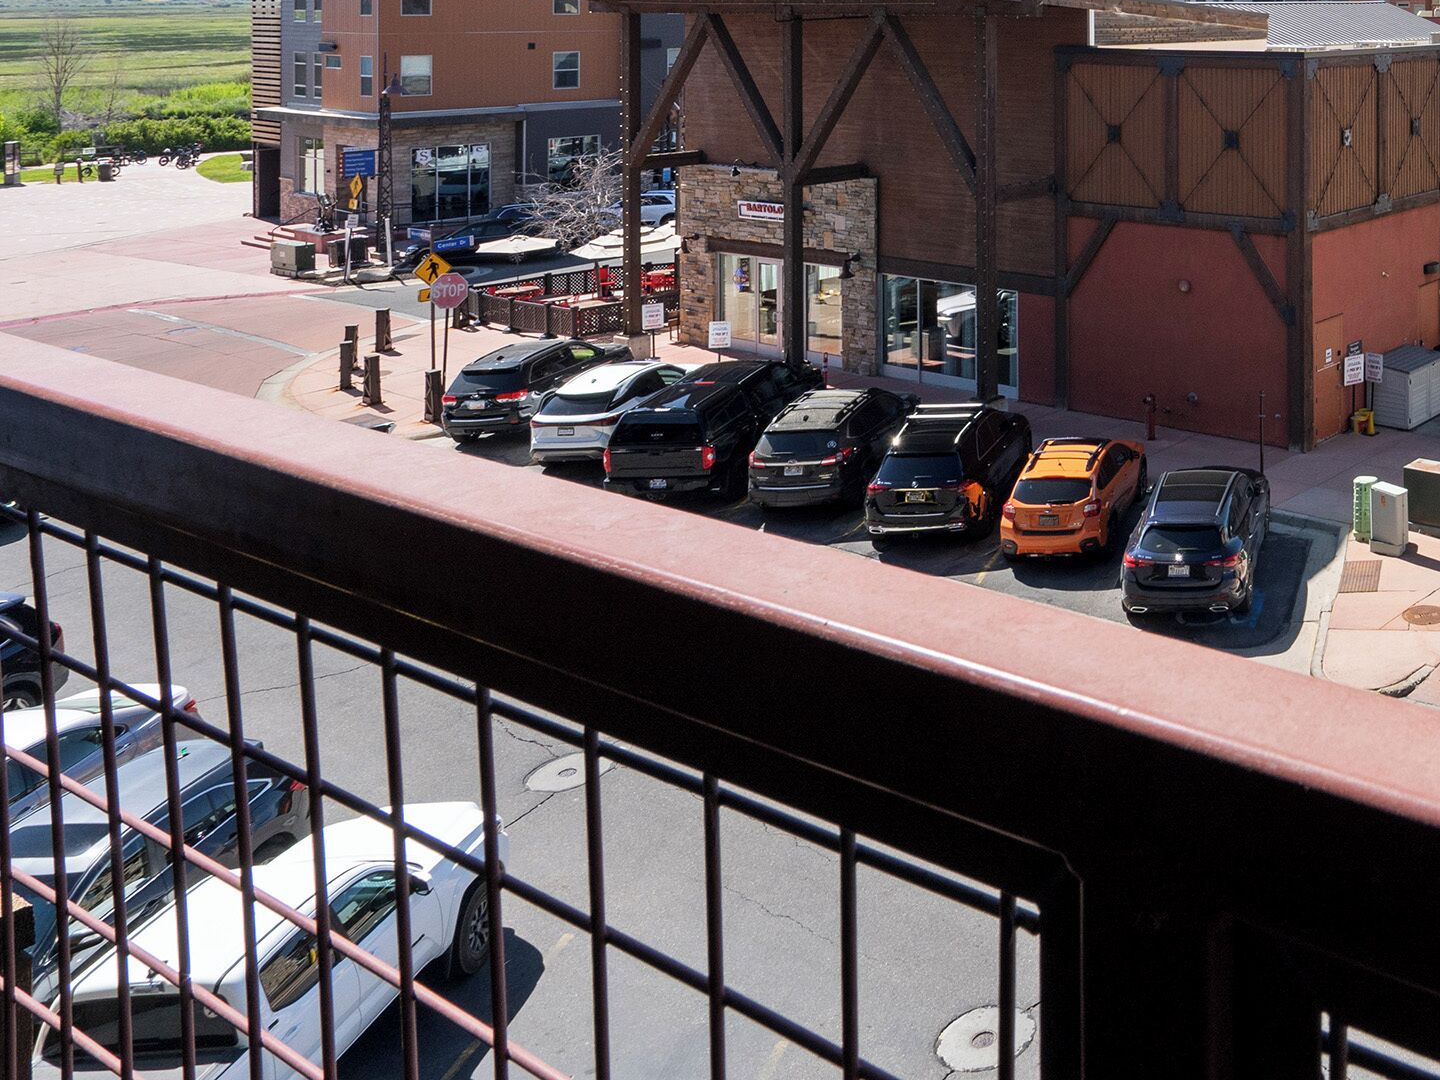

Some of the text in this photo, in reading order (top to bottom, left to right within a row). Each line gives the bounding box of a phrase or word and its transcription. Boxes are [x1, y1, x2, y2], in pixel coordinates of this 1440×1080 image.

[746, 203, 784, 214] BARTOLO
[437, 241, 457, 249] Center
[433, 283, 466, 299] STOP
